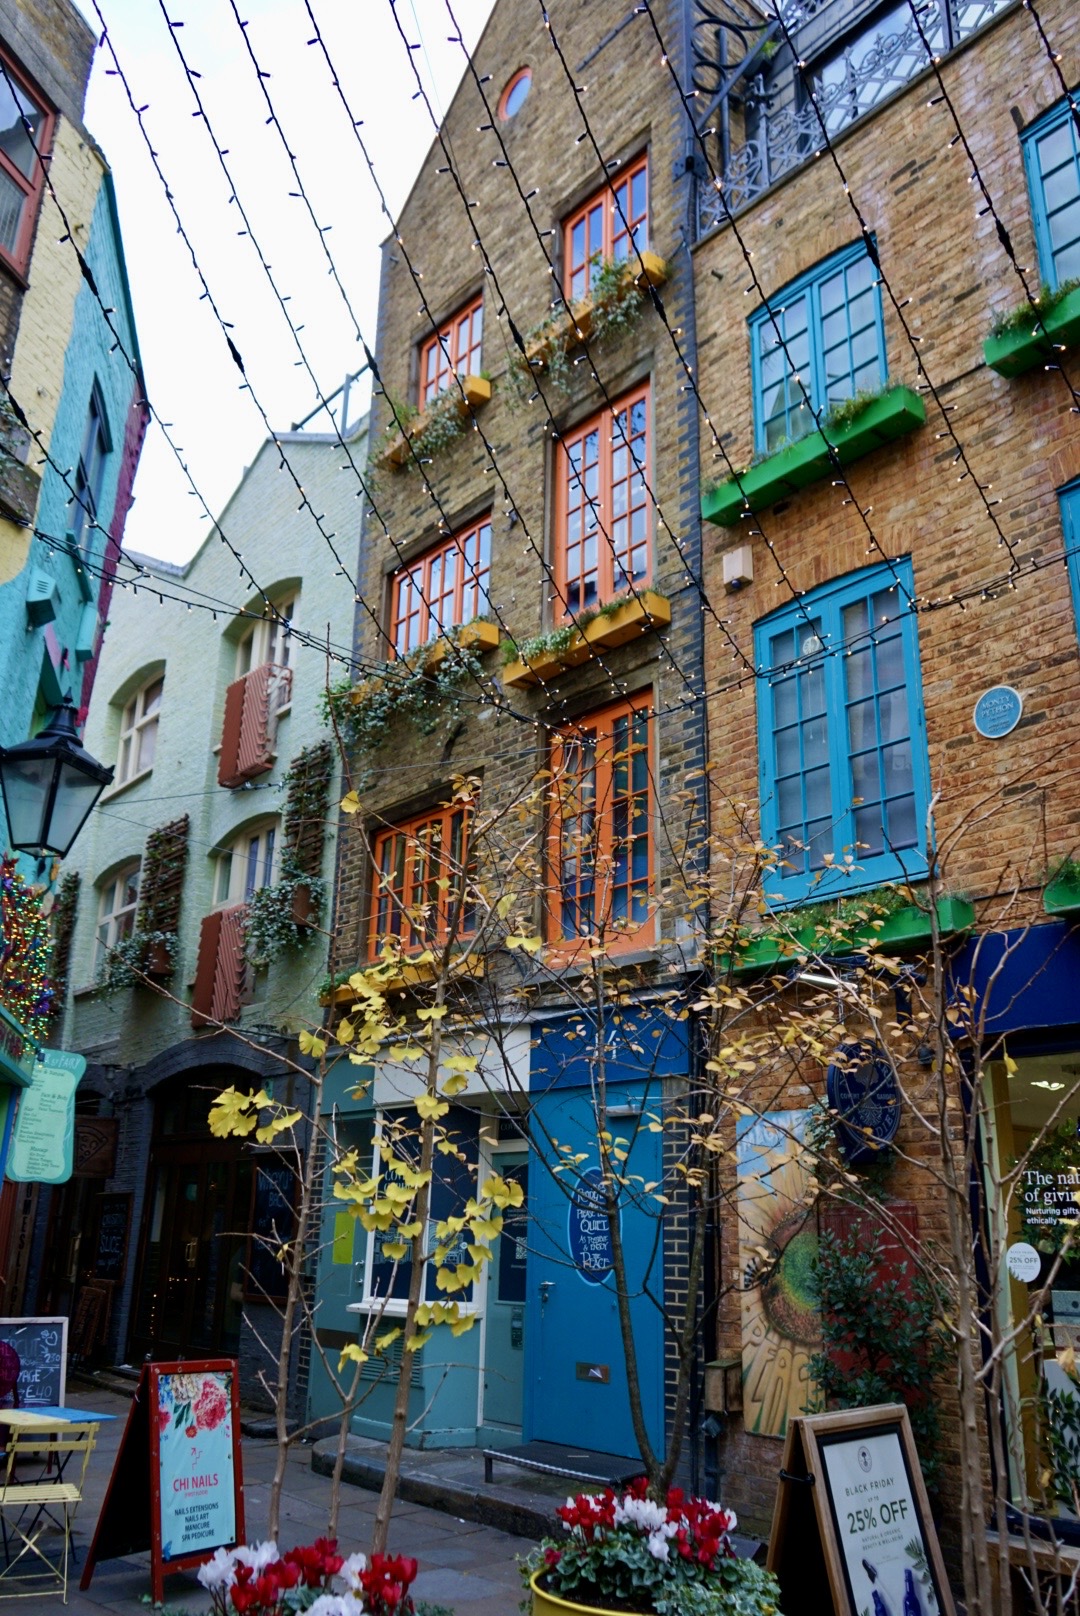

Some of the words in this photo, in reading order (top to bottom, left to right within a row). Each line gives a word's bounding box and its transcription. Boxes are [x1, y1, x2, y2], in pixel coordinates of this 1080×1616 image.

[982, 695, 1010, 708] MONTY
[982, 702, 1014, 717] PYTHON
[1022, 1170, 1054, 1185] The
[1057, 1172, 1080, 1185] nat
[1024, 1187, 1040, 1202] of
[1043, 1187, 1078, 1206] givin
[1025, 1207, 1061, 1216] Nurturing
[1026, 1217, 1057, 1226] ethically
[1009, 1256, 1022, 1264] 25%
[173, 1477, 189, 1492] CHI
[192, 1473, 219, 1488] NAILS
[845, 1483, 868, 1497] BLACK
[870, 1477, 895, 1490] FRIDAY
[174, 1507, 190, 1516] NAILS
[190, 1502, 219, 1514] EXTENSIONS
[185, 1514, 199, 1523] NAILS
[200, 1512, 209, 1520] ART
[847, 1507, 878, 1535] 25%
[880, 1499, 908, 1525] OFF
[184, 1521, 210, 1532] MANICURE
[182, 1534, 190, 1542] SPA
[191, 1529, 215, 1540] PEDICURE
[862, 1534, 880, 1543] NATURAL
[884, 1527, 902, 1537] ORGANIC
[882, 1535, 904, 1546] WELLBEING
